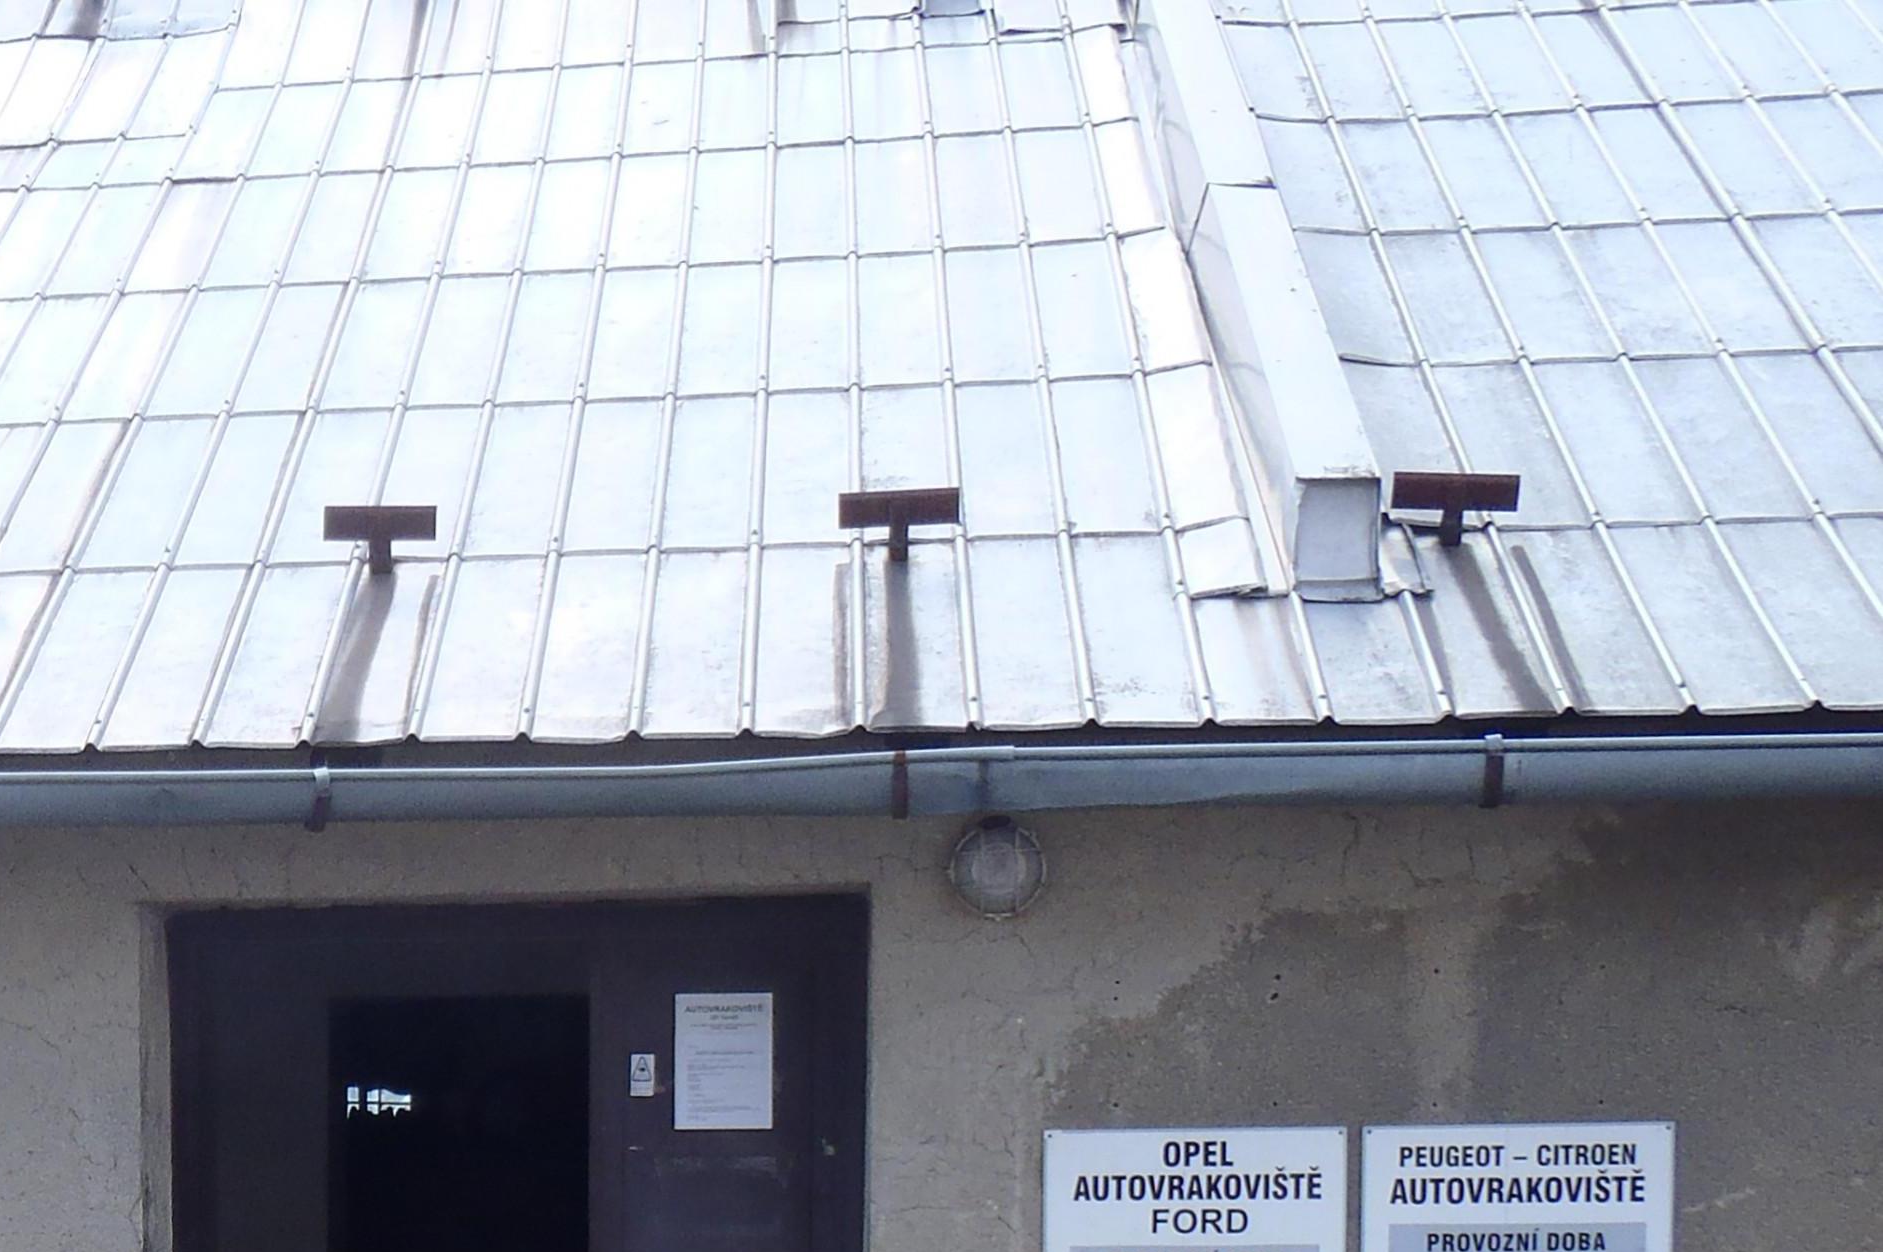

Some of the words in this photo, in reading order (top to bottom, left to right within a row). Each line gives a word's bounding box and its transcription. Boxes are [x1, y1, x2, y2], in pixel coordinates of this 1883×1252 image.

[1162, 1140, 1235, 1168] OPEL
[1398, 1144, 1505, 1168] PEUGEOT
[1536, 1143, 1637, 1168] CITROEN
[1073, 1165, 1323, 1202] AUTOVRAKOVIŠTĚ
[1390, 1168, 1646, 1204] AUTOVRAKOVIŠTĚ
[1151, 1208, 1249, 1235] FORD
[1426, 1227, 1539, 1252] PROVOZNÍ
[1546, 1231, 1606, 1252] DOBA
